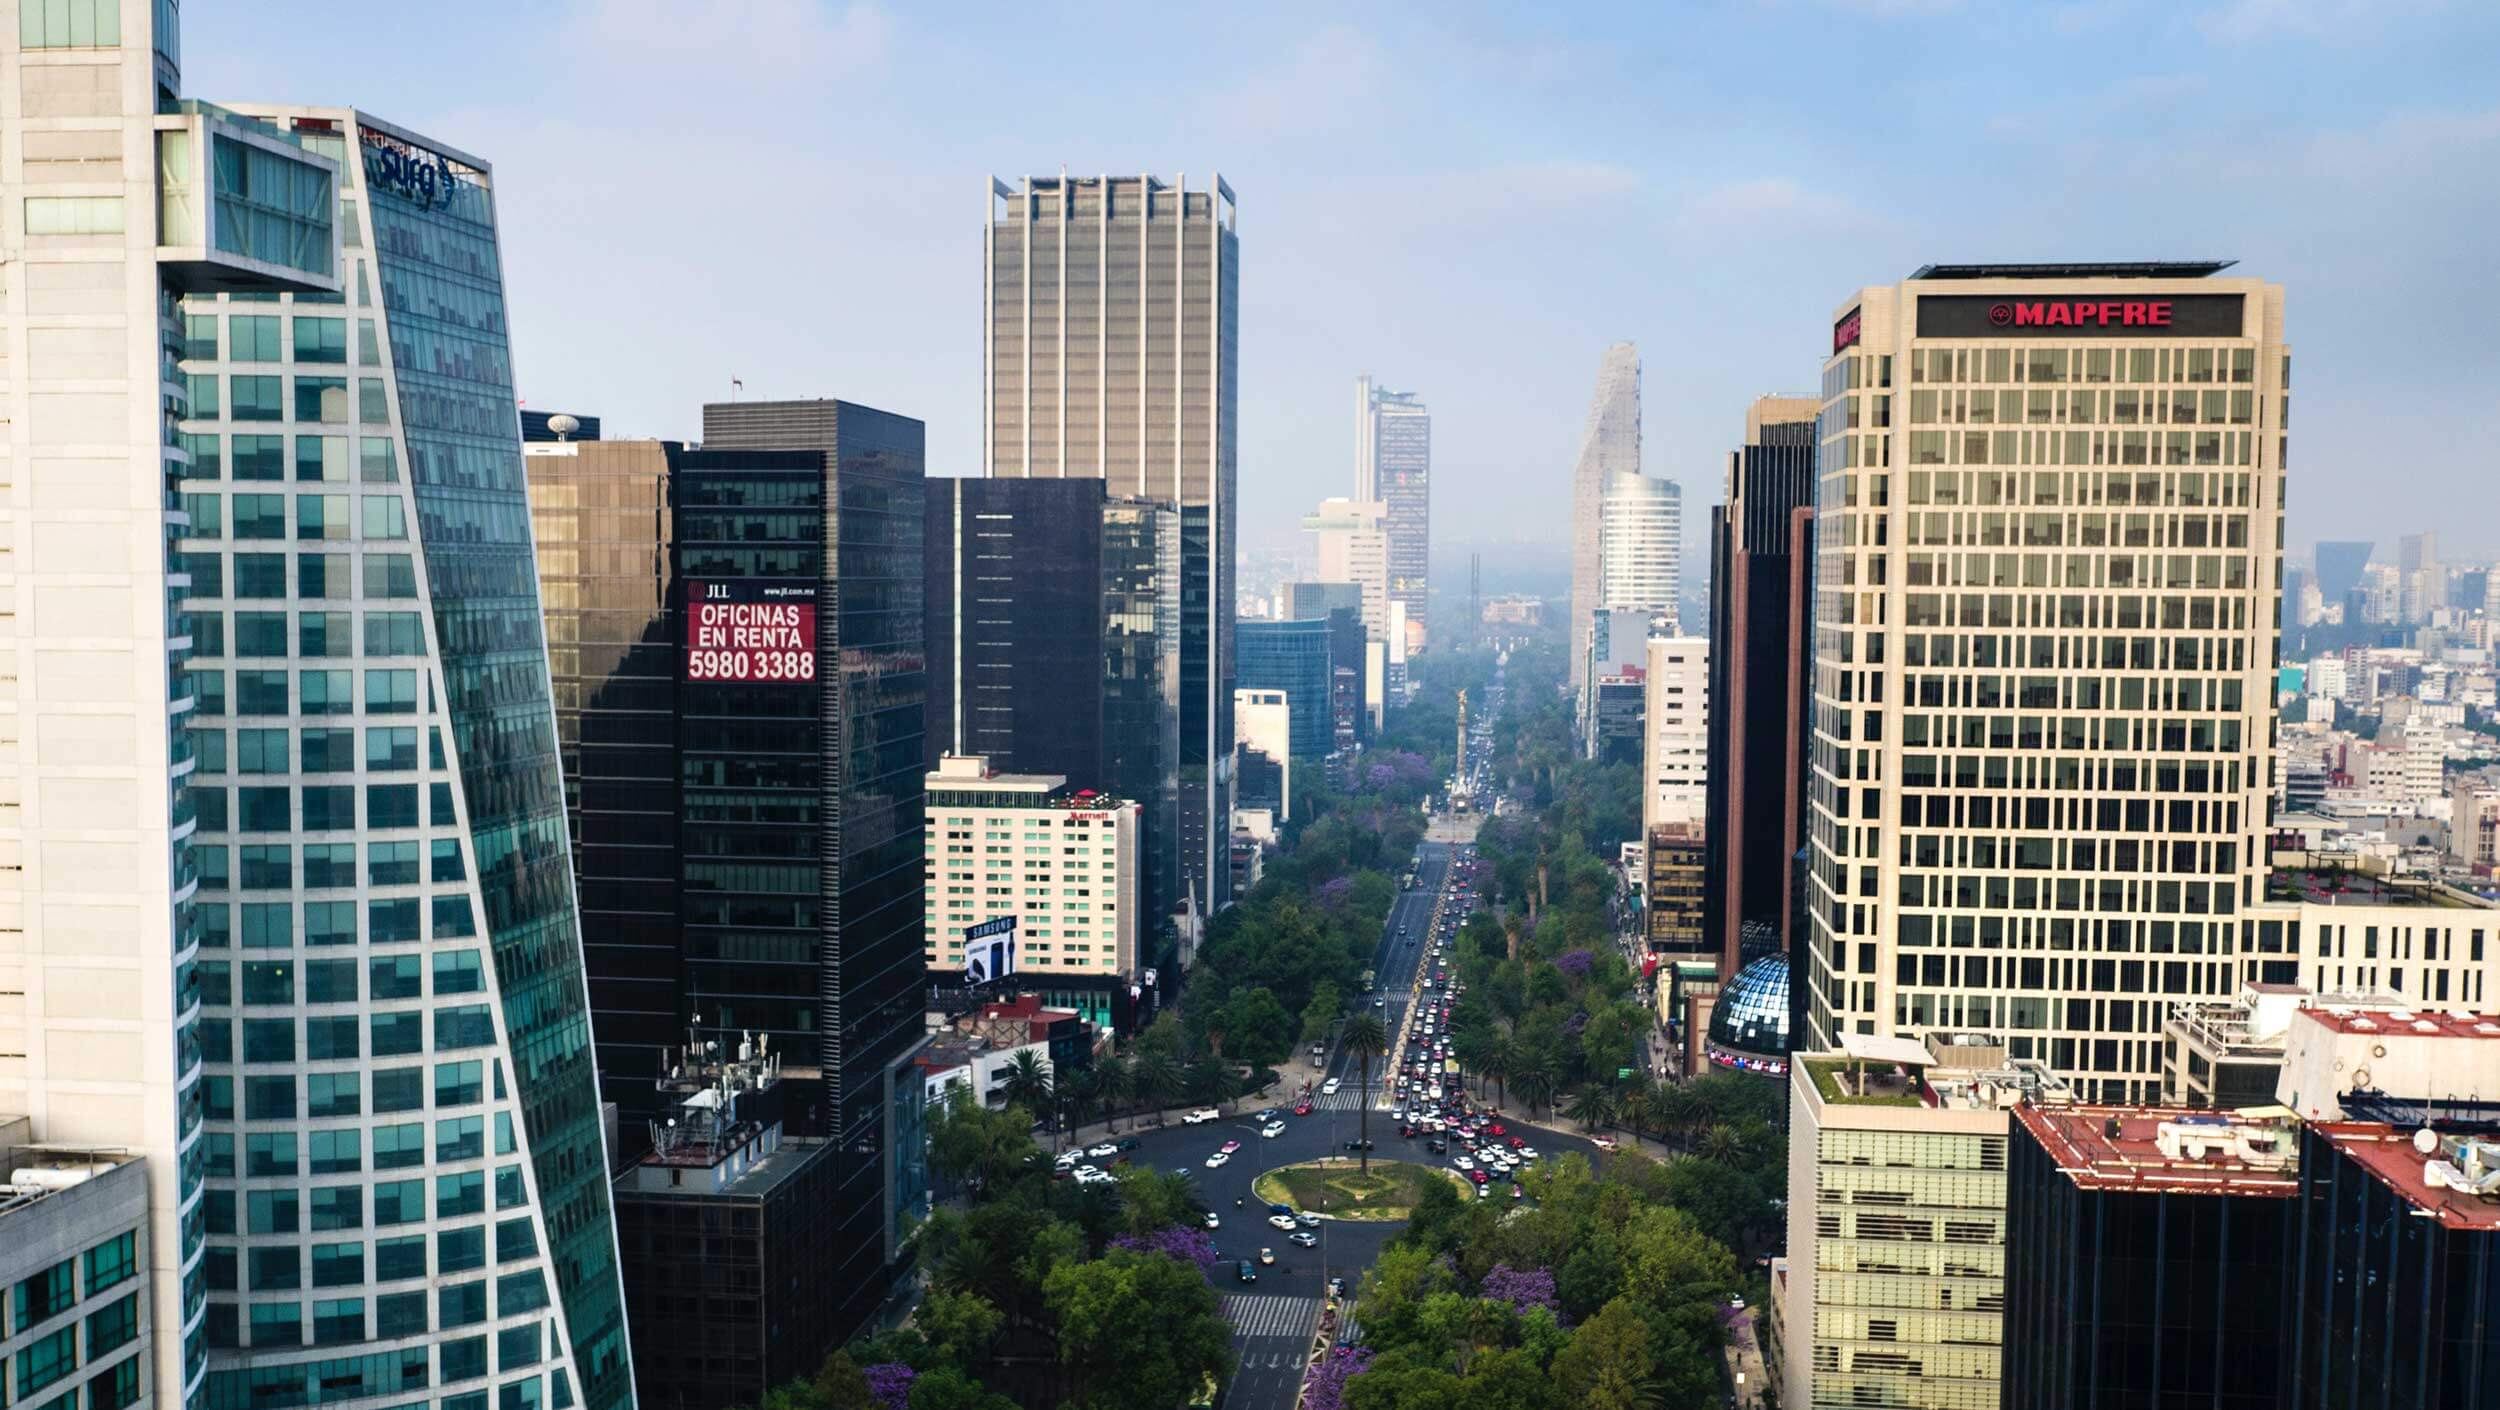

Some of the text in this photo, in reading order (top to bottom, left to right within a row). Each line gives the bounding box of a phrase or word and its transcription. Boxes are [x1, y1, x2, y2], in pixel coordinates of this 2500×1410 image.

[2015, 302, 2173, 326] MAPFRE
[706, 585, 730, 598] JLL
[701, 605, 800, 626] OFICINAS
[698, 627, 803, 648] EN RENTA
[689, 650, 815, 679] 5980 3388
[973, 918, 1012, 939] SAMSUNG
